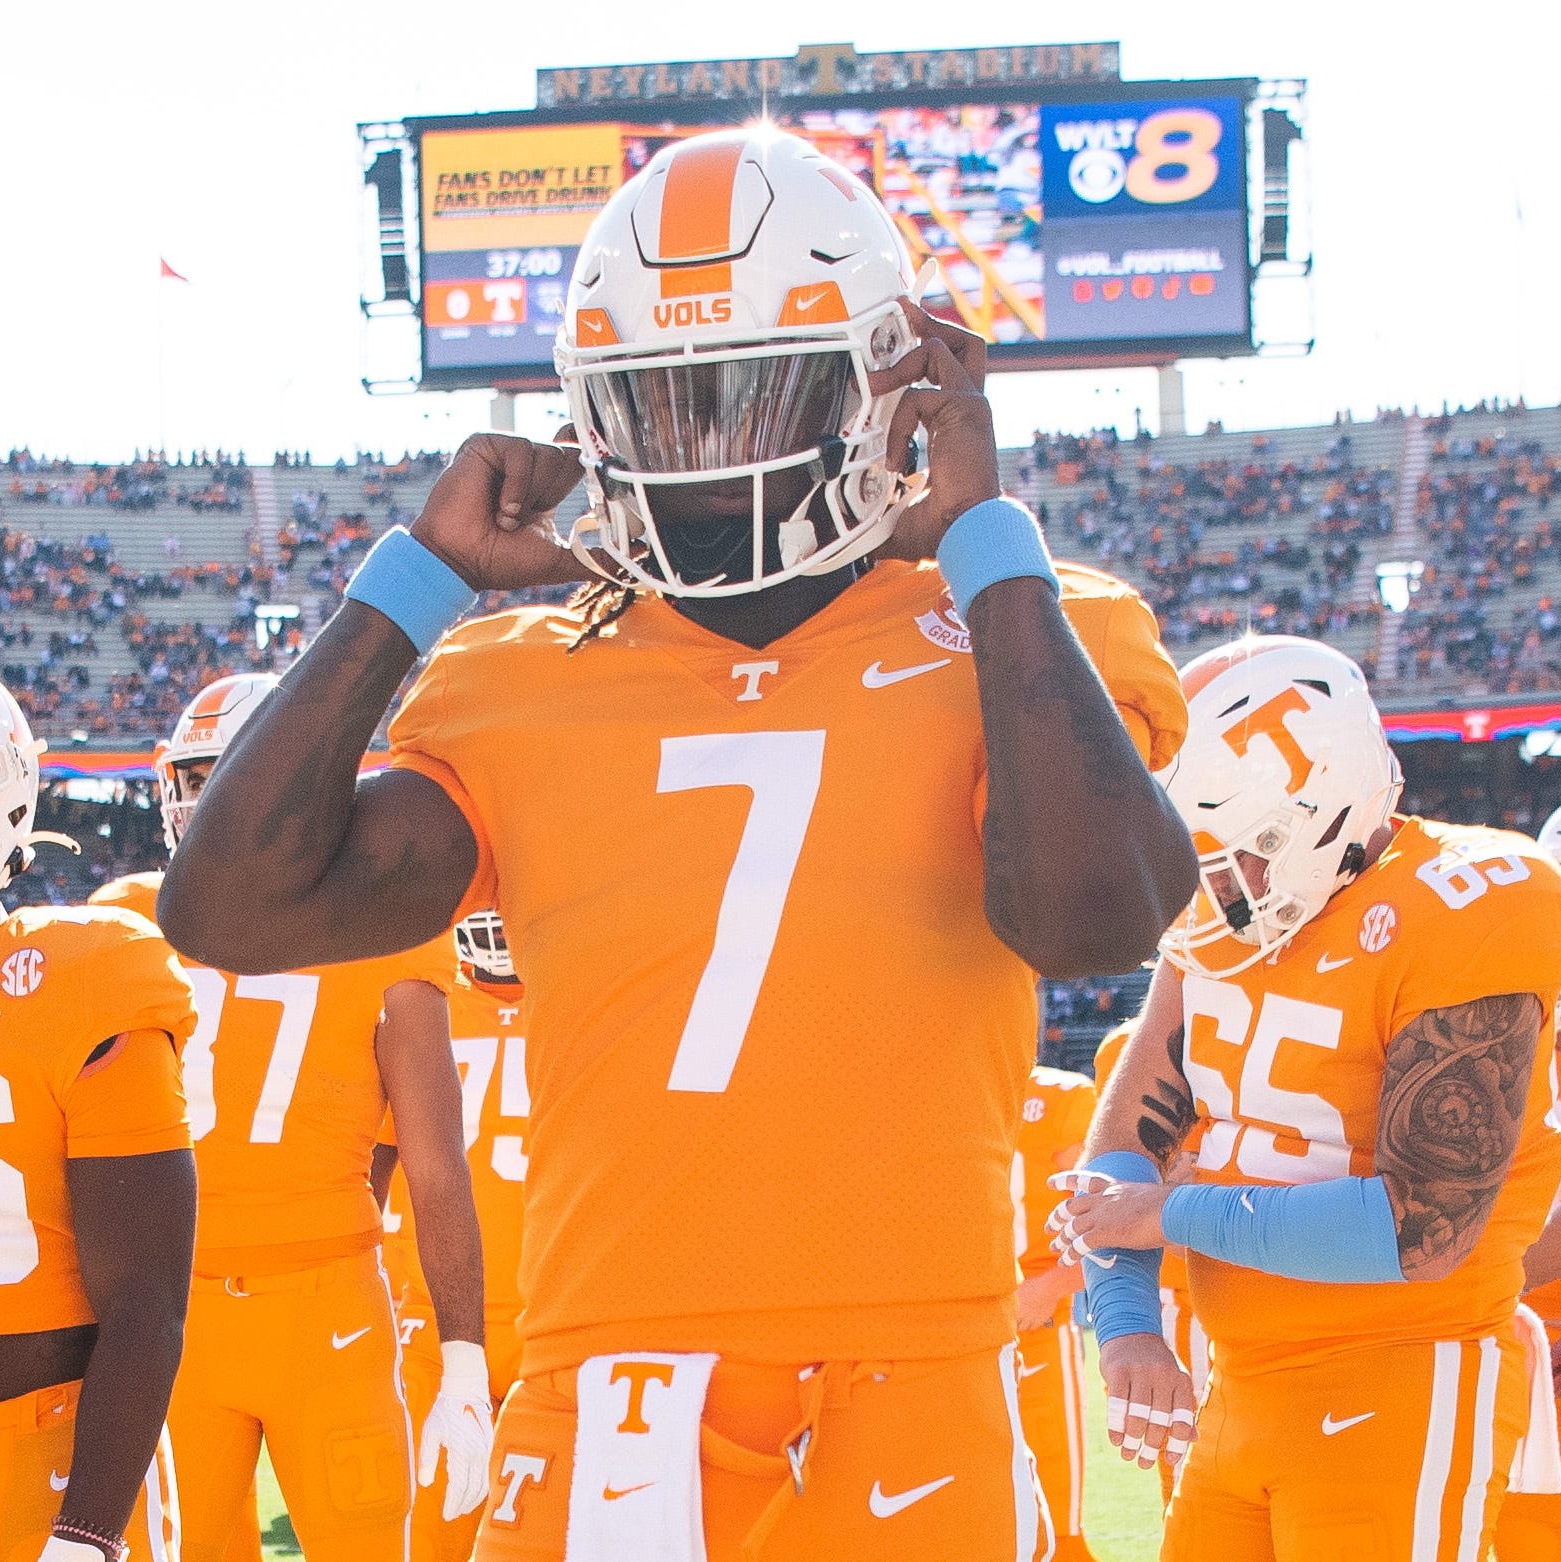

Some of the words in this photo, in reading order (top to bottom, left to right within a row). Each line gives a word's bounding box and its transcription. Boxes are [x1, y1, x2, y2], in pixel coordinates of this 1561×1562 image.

[553, 58, 783, 100] NEYLAND
[795, 43, 858, 95] T
[870, 44, 1104, 84] STADIUM
[1054, 120, 1137, 152] WVLT
[1125, 108, 1223, 205] 8
[434, 190, 481, 209] FANS
[485, 188, 539, 206] DRIVE
[544, 185, 613, 203] DRUNK
[438, 170, 493, 192] FANS
[498, 166, 566, 188] DON'T
[573, 164, 612, 184] LET
[486, 249, 563, 277] 37:00
[482, 279, 523, 322] T
[653, 297, 733, 330] VOLS
[731, 661, 780, 702] T
[182, 729, 214, 744] VOLS
[1220, 686, 1315, 796] T
[655, 729, 827, 1094] 7
[1358, 903, 1398, 954] SEC
[0, 948, 44, 997] SEC
[497, 1007, 519, 1026] T
[1182, 976, 1355, 1186] 65
[400, 1318, 426, 1345] T
[608, 1360, 675, 1435] T
[492, 1455, 548, 1524] T
